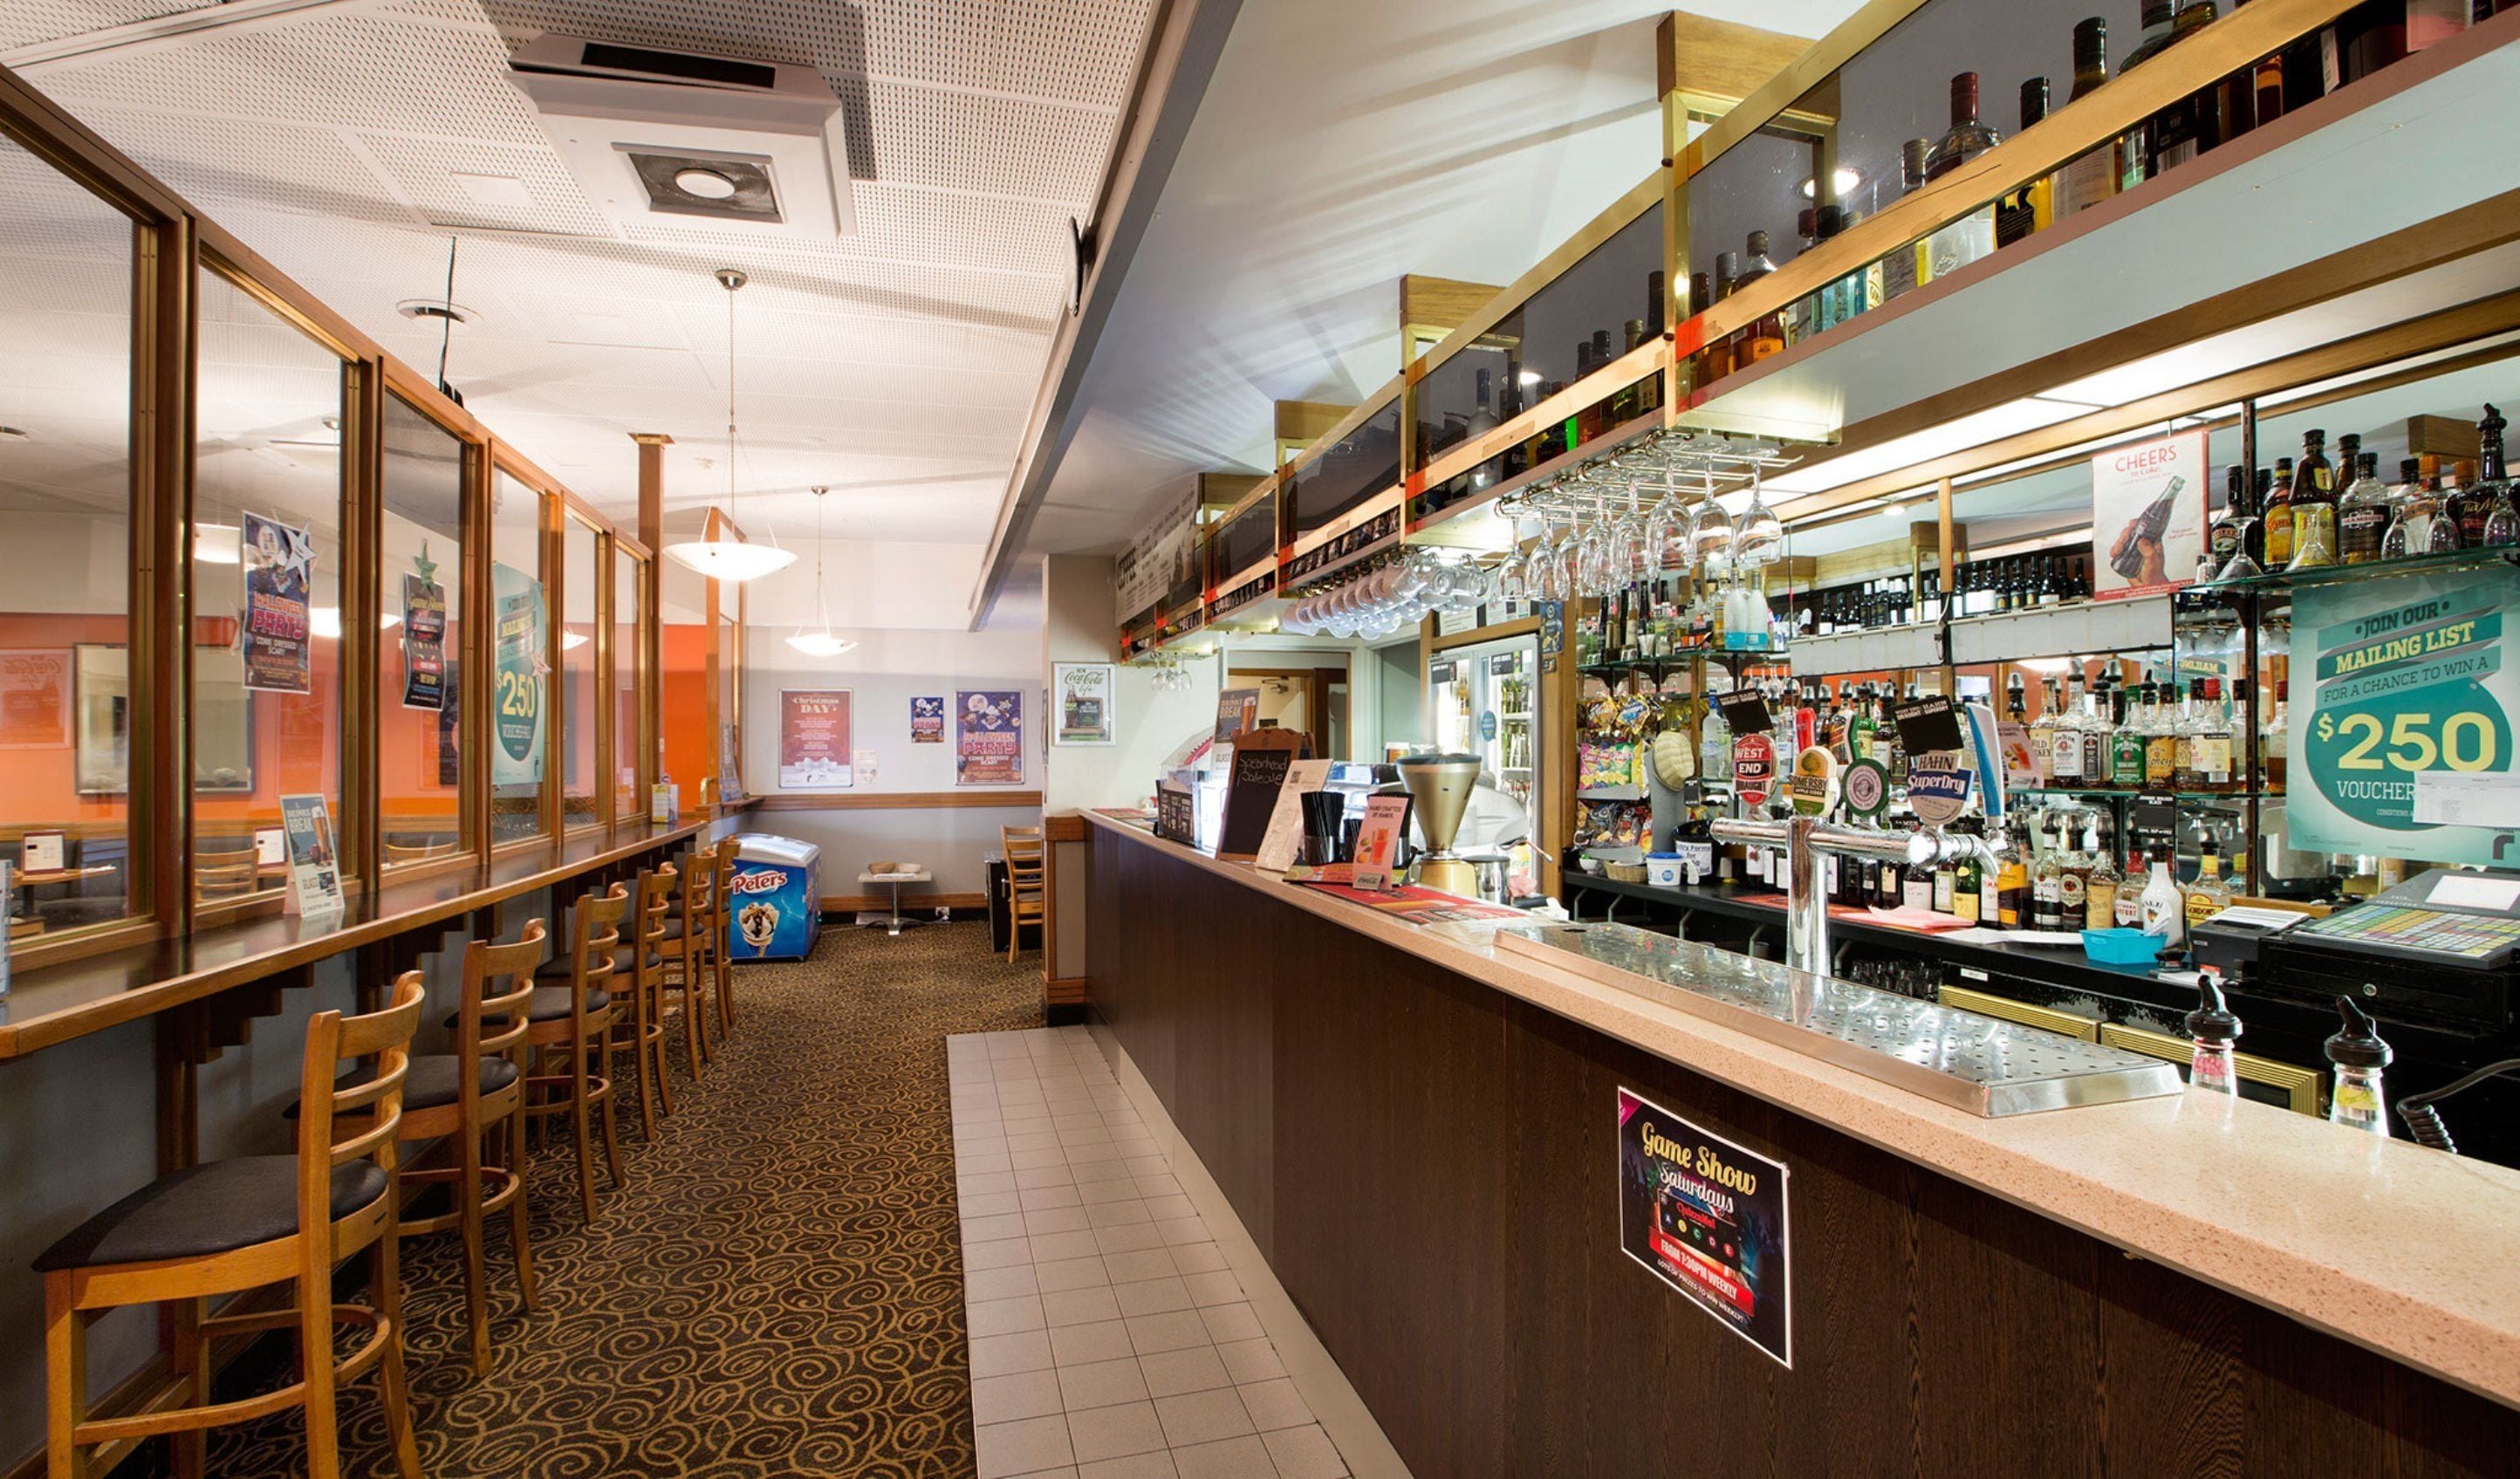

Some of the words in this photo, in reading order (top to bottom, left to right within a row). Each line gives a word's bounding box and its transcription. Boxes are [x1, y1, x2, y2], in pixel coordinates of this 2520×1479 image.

[2115, 445, 2177, 472] CHEERS
[252, 608, 305, 640] PARTY
[2364, 611, 2399, 640] JOIN
[2403, 603, 2439, 626] OUR
[2336, 633, 2421, 674] MAILING
[2425, 621, 2475, 653] LIST
[2325, 684, 2347, 702] FOR
[2350, 684, 2360, 697] A
[2363, 671, 2418, 694] CHANCE
[2422, 668, 2441, 682] TO
[2443, 660, 2475, 677] WIN
[2478, 656, 2489, 669] A
[801, 704, 831, 713] DAY
[963, 742, 1016, 755] PARTY
[1736, 747, 1766, 759] WEST
[2317, 711, 2496, 773] $250
[1738, 763, 1762, 774] END
[1919, 756, 1955, 770] HAHN
[1907, 774, 1966, 796] SuperDry
[2336, 780, 2415, 801] VOUCHER
[732, 871, 787, 894] Peters
[1642, 1121, 1692, 1169] Game
[1695, 1146, 1756, 1196] Show
[1660, 1161, 1735, 1217] Saturdays
[1661, 1238, 1681, 1261] FROM
[1707, 1269, 1738, 1301] WEEKLY
